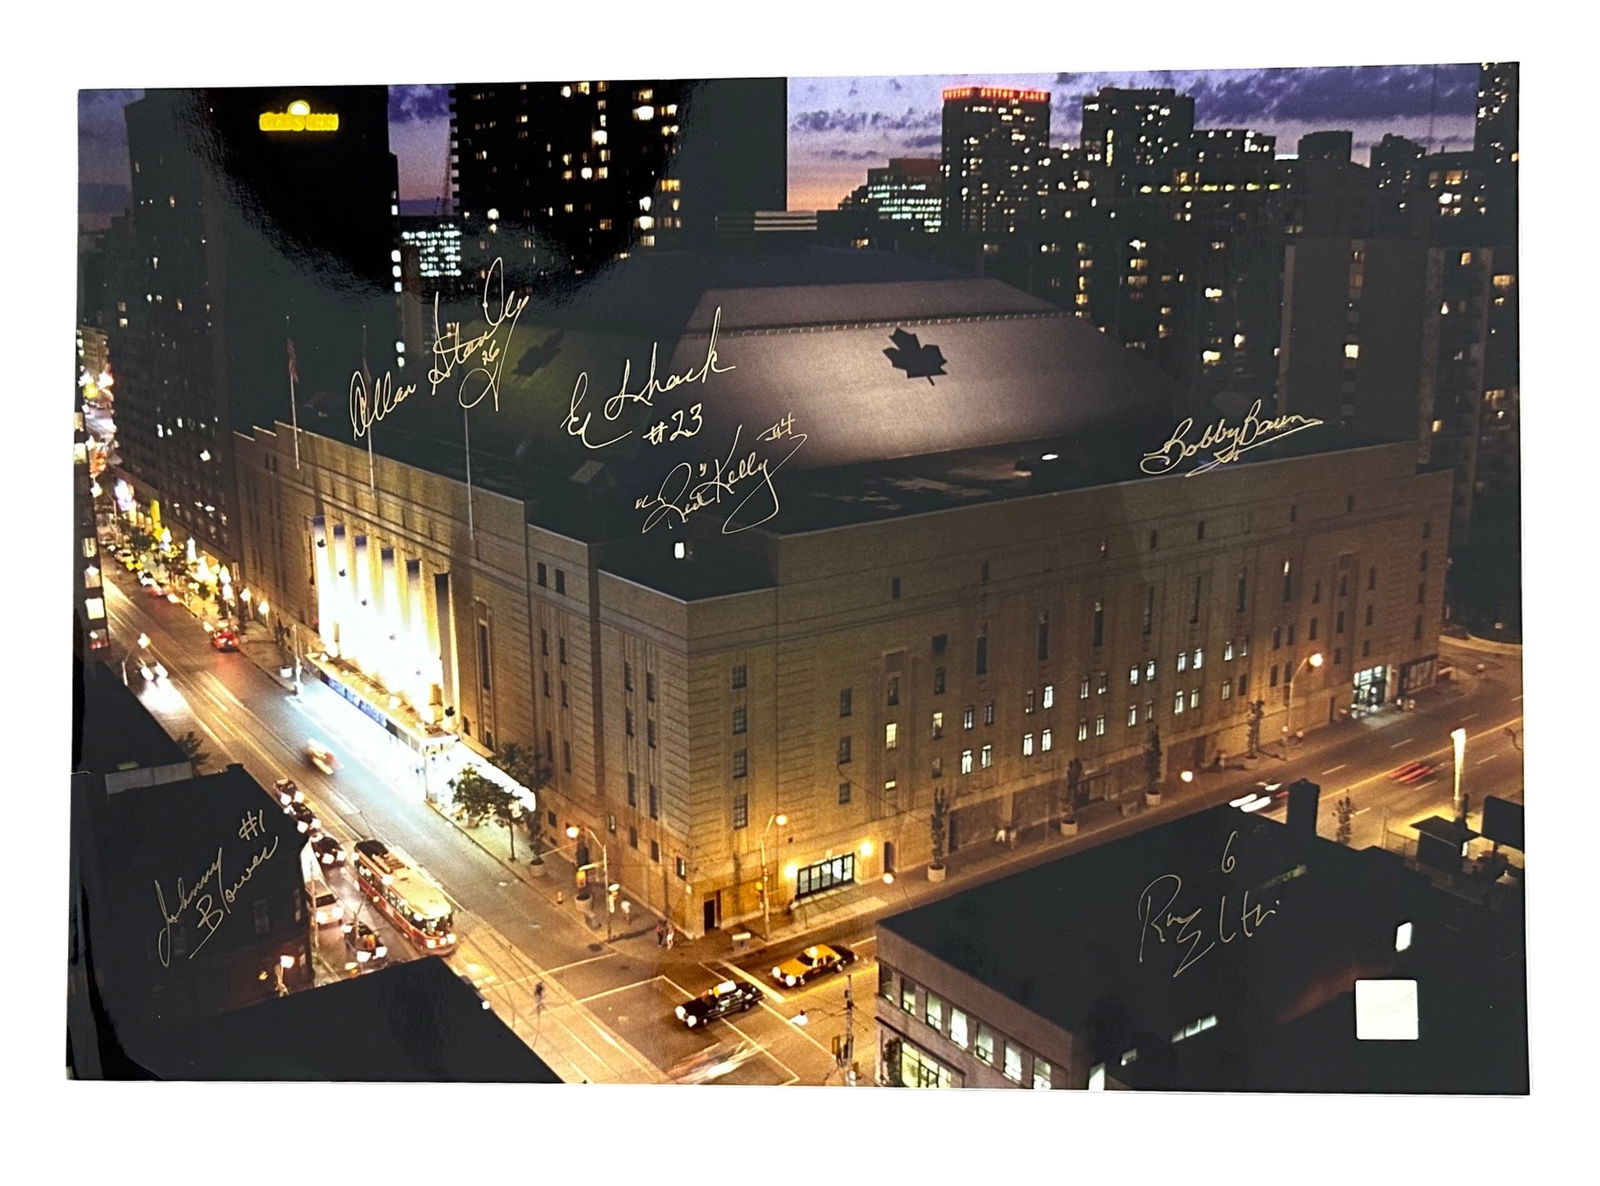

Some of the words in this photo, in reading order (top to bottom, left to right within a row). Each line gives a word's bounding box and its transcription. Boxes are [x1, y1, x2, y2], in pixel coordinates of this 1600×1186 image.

[350, 370, 417, 441] Allan
[428, 256, 530, 412] Stanley
[642, 402, 703, 446] #23
[1139, 417, 1240, 475] Bobby
[689, 423, 808, 534] Kelly
[238, 808, 266, 841] #1
[1220, 829, 1239, 874] 6
[154, 846, 232, 968] Johnny
[188, 835, 279, 960] Bower
